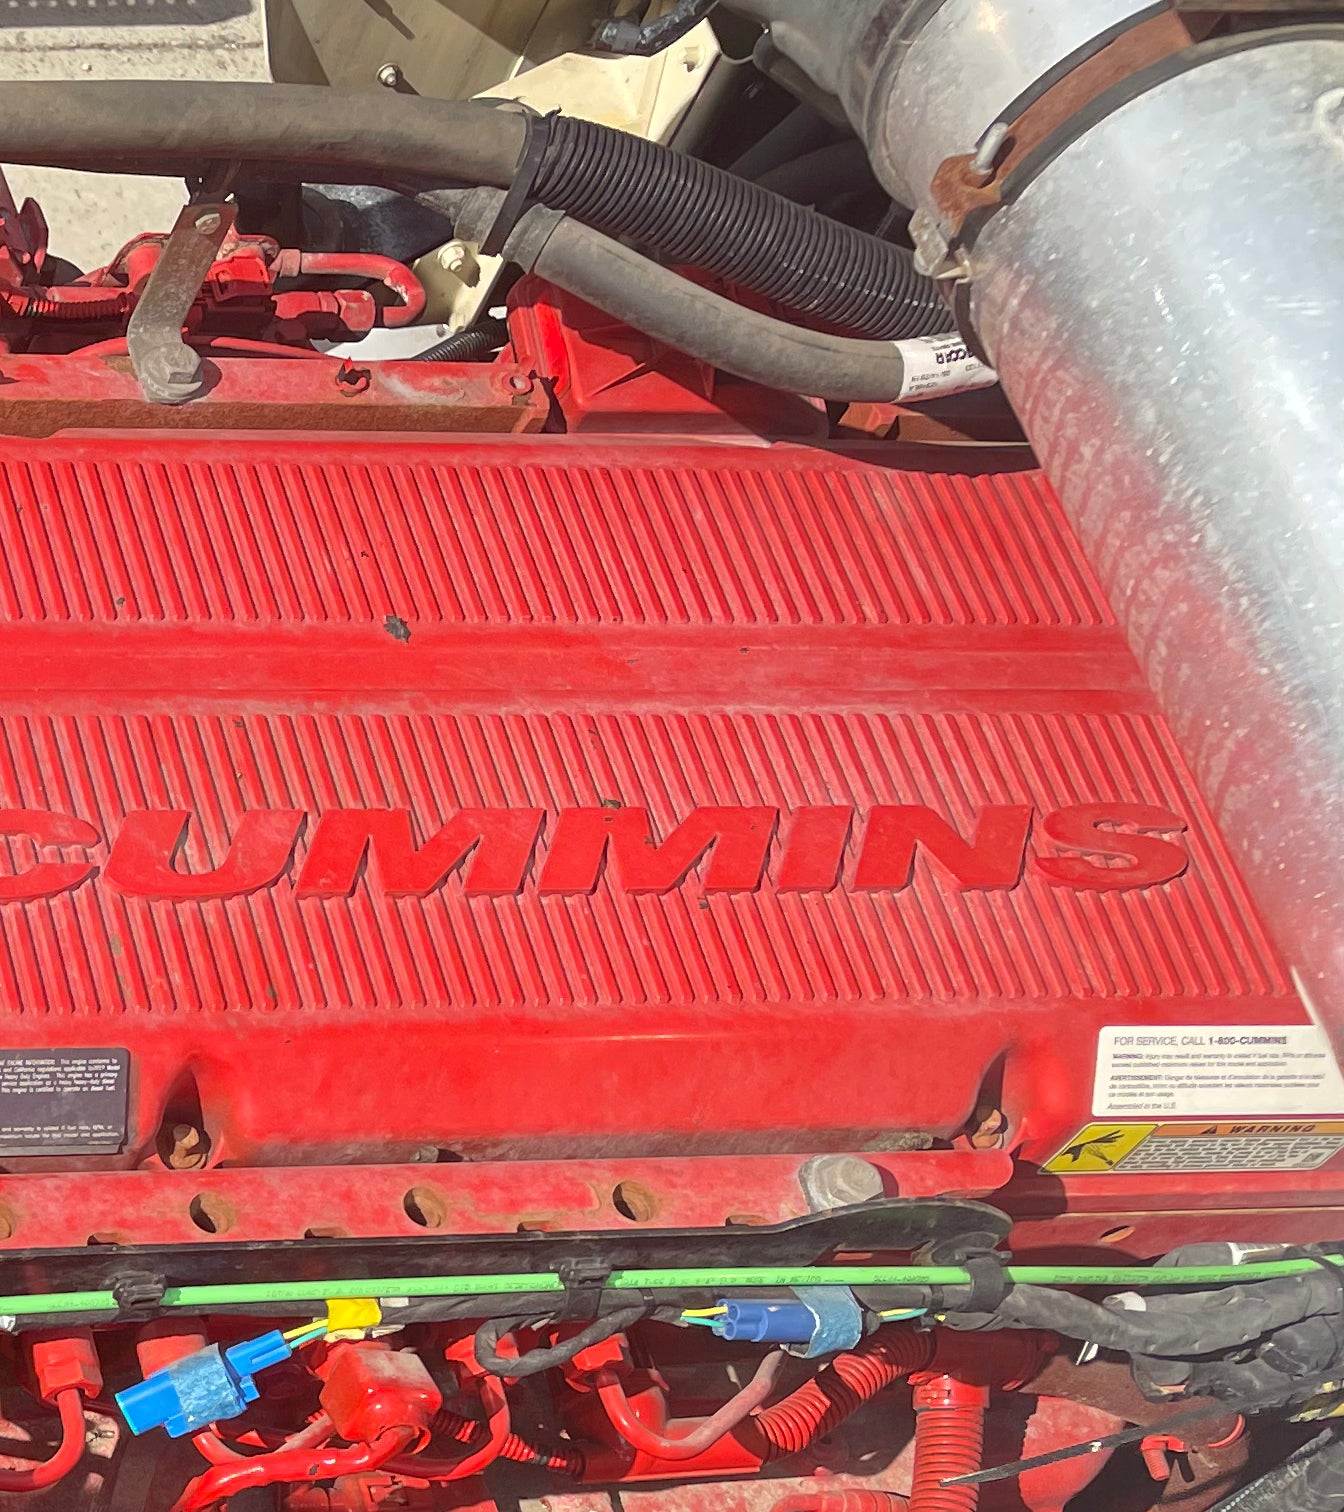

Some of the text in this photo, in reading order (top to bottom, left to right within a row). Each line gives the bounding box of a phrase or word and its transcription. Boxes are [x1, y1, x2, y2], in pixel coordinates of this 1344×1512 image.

[1114, 1036, 1134, 1046] FOR
[1136, 1036, 1179, 1047] SERVICE,
[1181, 1036, 1206, 1046] CALL
[1229, 1124, 1316, 1134] WARNING
